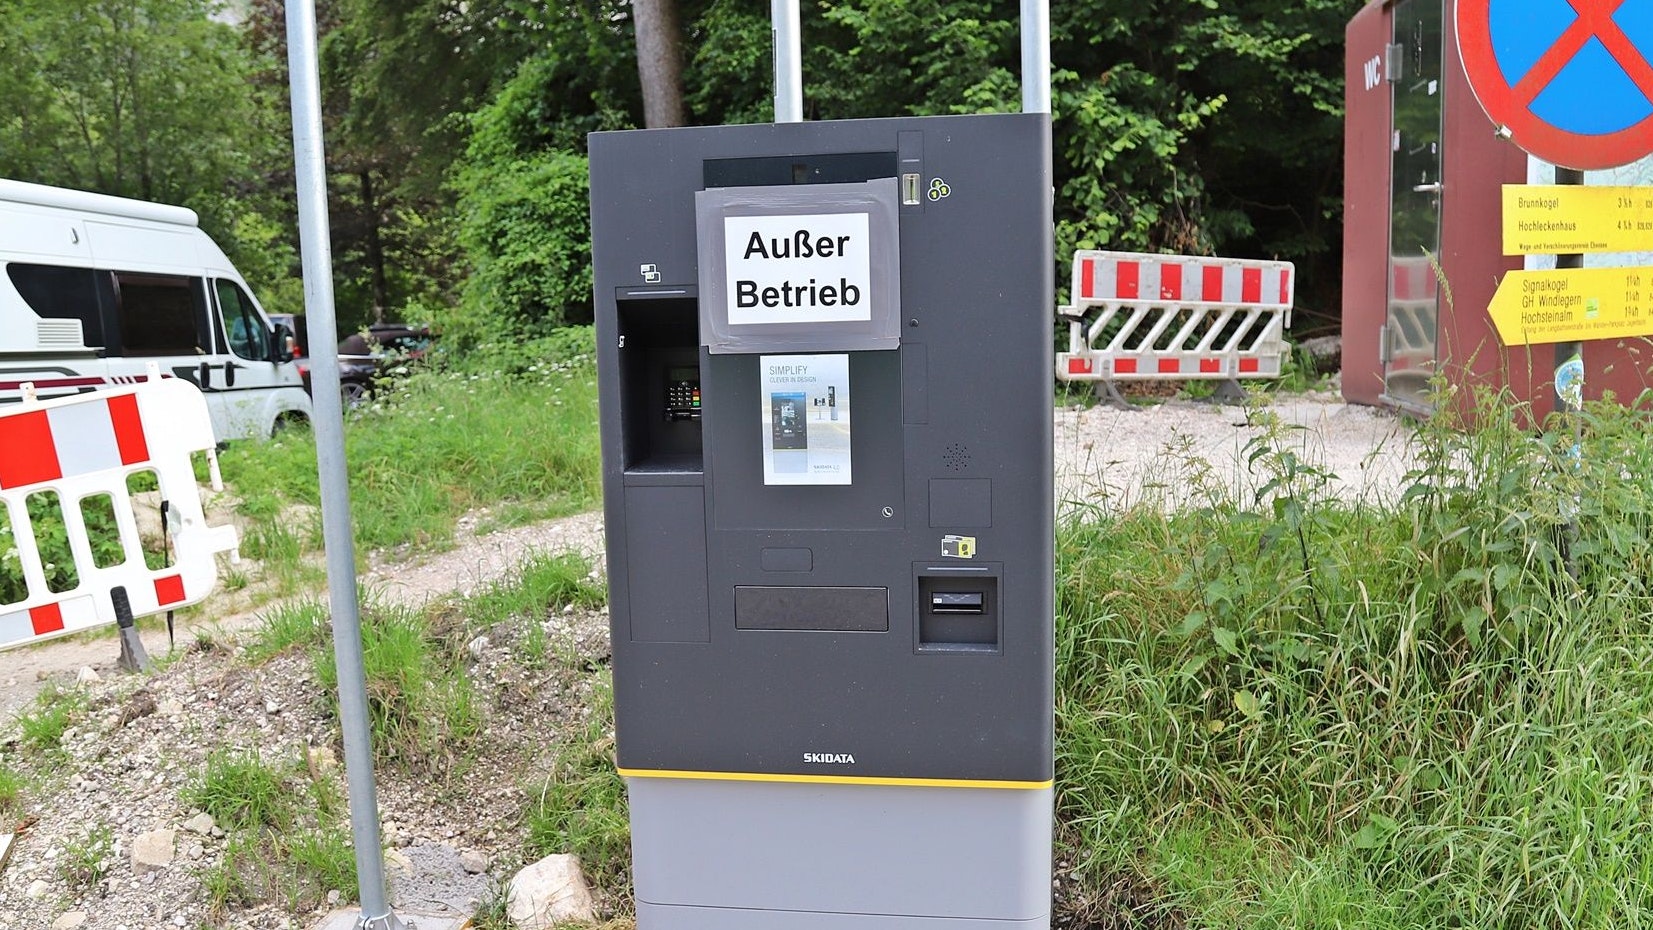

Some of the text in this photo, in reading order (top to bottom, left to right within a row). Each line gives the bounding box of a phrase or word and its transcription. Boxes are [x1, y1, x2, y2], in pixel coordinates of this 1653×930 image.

[1364, 55, 1381, 91] WC
[1518, 197, 1559, 210] Brunnkogel
[1518, 220, 1577, 232] Hochleckenhaus
[743, 229, 850, 259] Außer
[1522, 277, 1568, 294] Signalkogel
[736, 278, 860, 308] Betrieb
[1522, 295, 1534, 308] GH
[1539, 294, 1582, 308] Windlegern
[1521, 310, 1573, 325] Hochsteinalm
[769, 365, 808, 376] SIMPLIFY
[803, 752, 856, 764] SKIDATA
